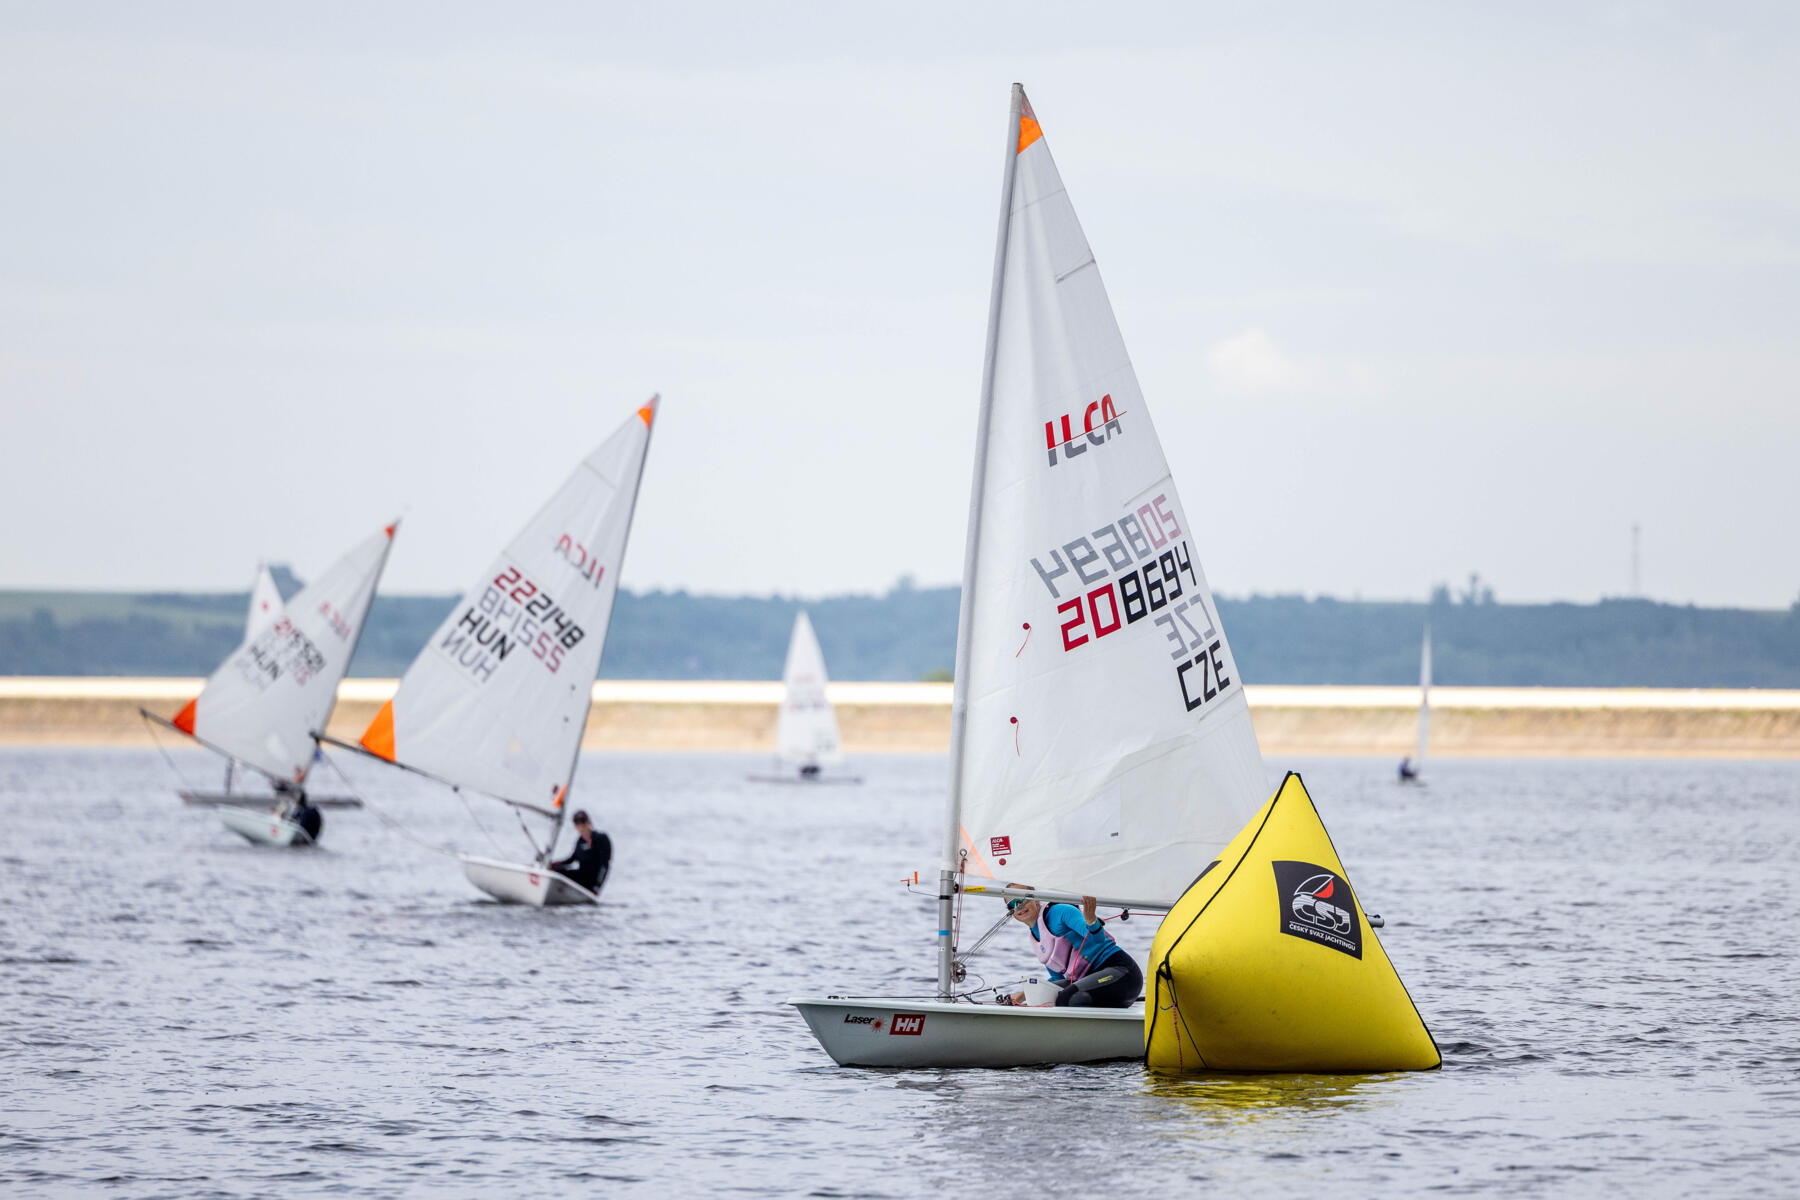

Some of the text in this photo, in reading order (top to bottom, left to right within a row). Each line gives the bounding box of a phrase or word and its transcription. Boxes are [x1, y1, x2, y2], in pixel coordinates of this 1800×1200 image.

[1045, 394, 1122, 467] ILCA
[493, 566, 585, 650] 222148
[1057, 541, 1197, 652] 208694
[458, 607, 516, 661] HUN
[1176, 640, 1231, 712] CZE
[1309, 929, 1325, 939] SVAZ
[1324, 935, 1356, 951] JACHTINGU
[844, 1013, 875, 1024] Laser
[894, 1017, 920, 1032] HH
